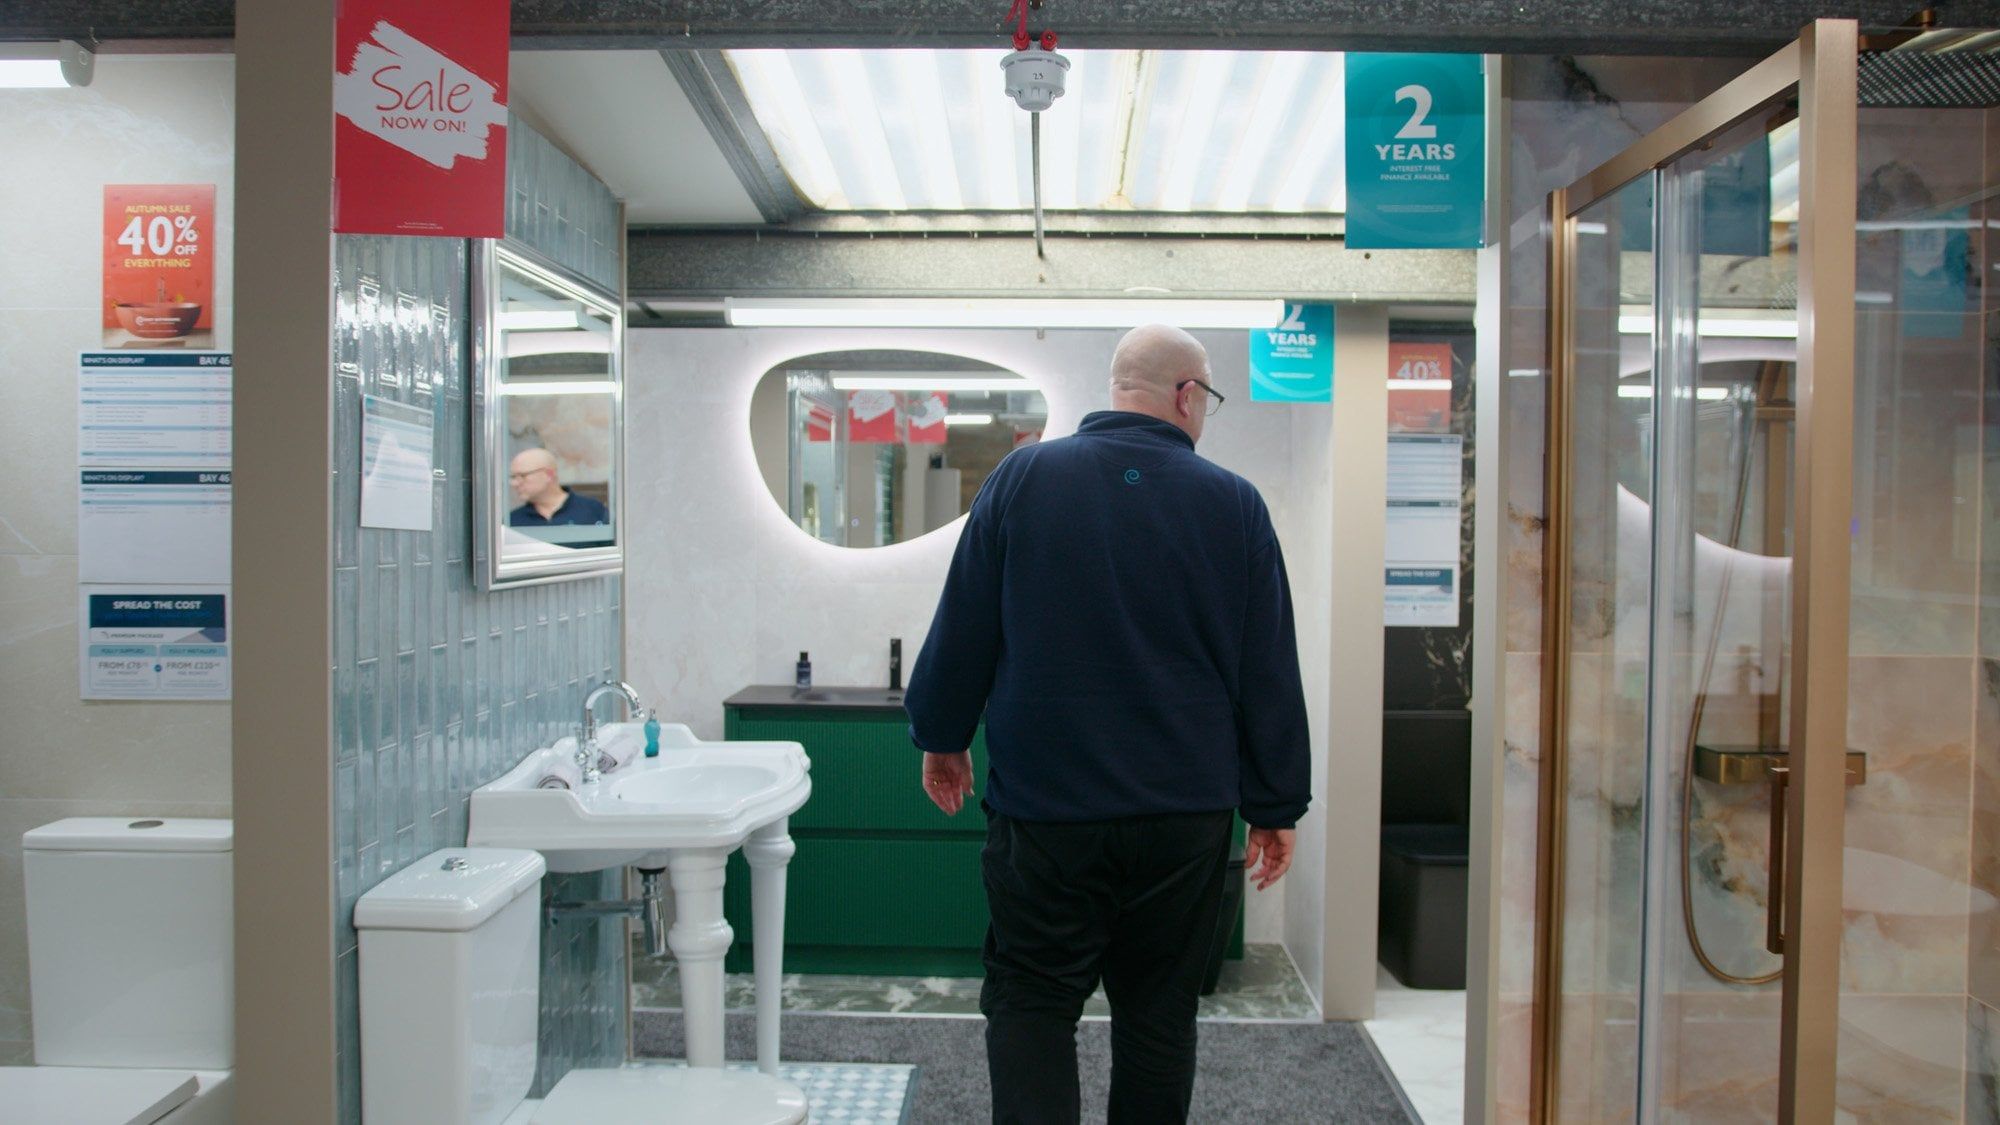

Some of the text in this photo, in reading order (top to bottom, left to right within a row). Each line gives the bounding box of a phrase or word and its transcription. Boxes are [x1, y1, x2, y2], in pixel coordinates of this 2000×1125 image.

[372, 65, 473, 113] Sale
[1394, 84, 1437, 139] 2
[381, 116, 466, 132] NOW ON!
[1375, 144, 1456, 160] YEARS
[1380, 173, 1413, 181] FINANCE
[125, 205, 191, 213] AUTUMN SALE
[117, 215, 198, 256] 40%
[174, 244, 198, 255] OFF
[124, 258, 191, 268] EVERYTHING
[1267, 332, 1317, 346] YEARS
[199, 356, 230, 365] BAY 46
[199, 474, 217, 483] BAY
[113, 601, 202, 609] SPREAD THE COST
[98, 661, 125, 670] FROM
[166, 661, 192, 670] FROM
